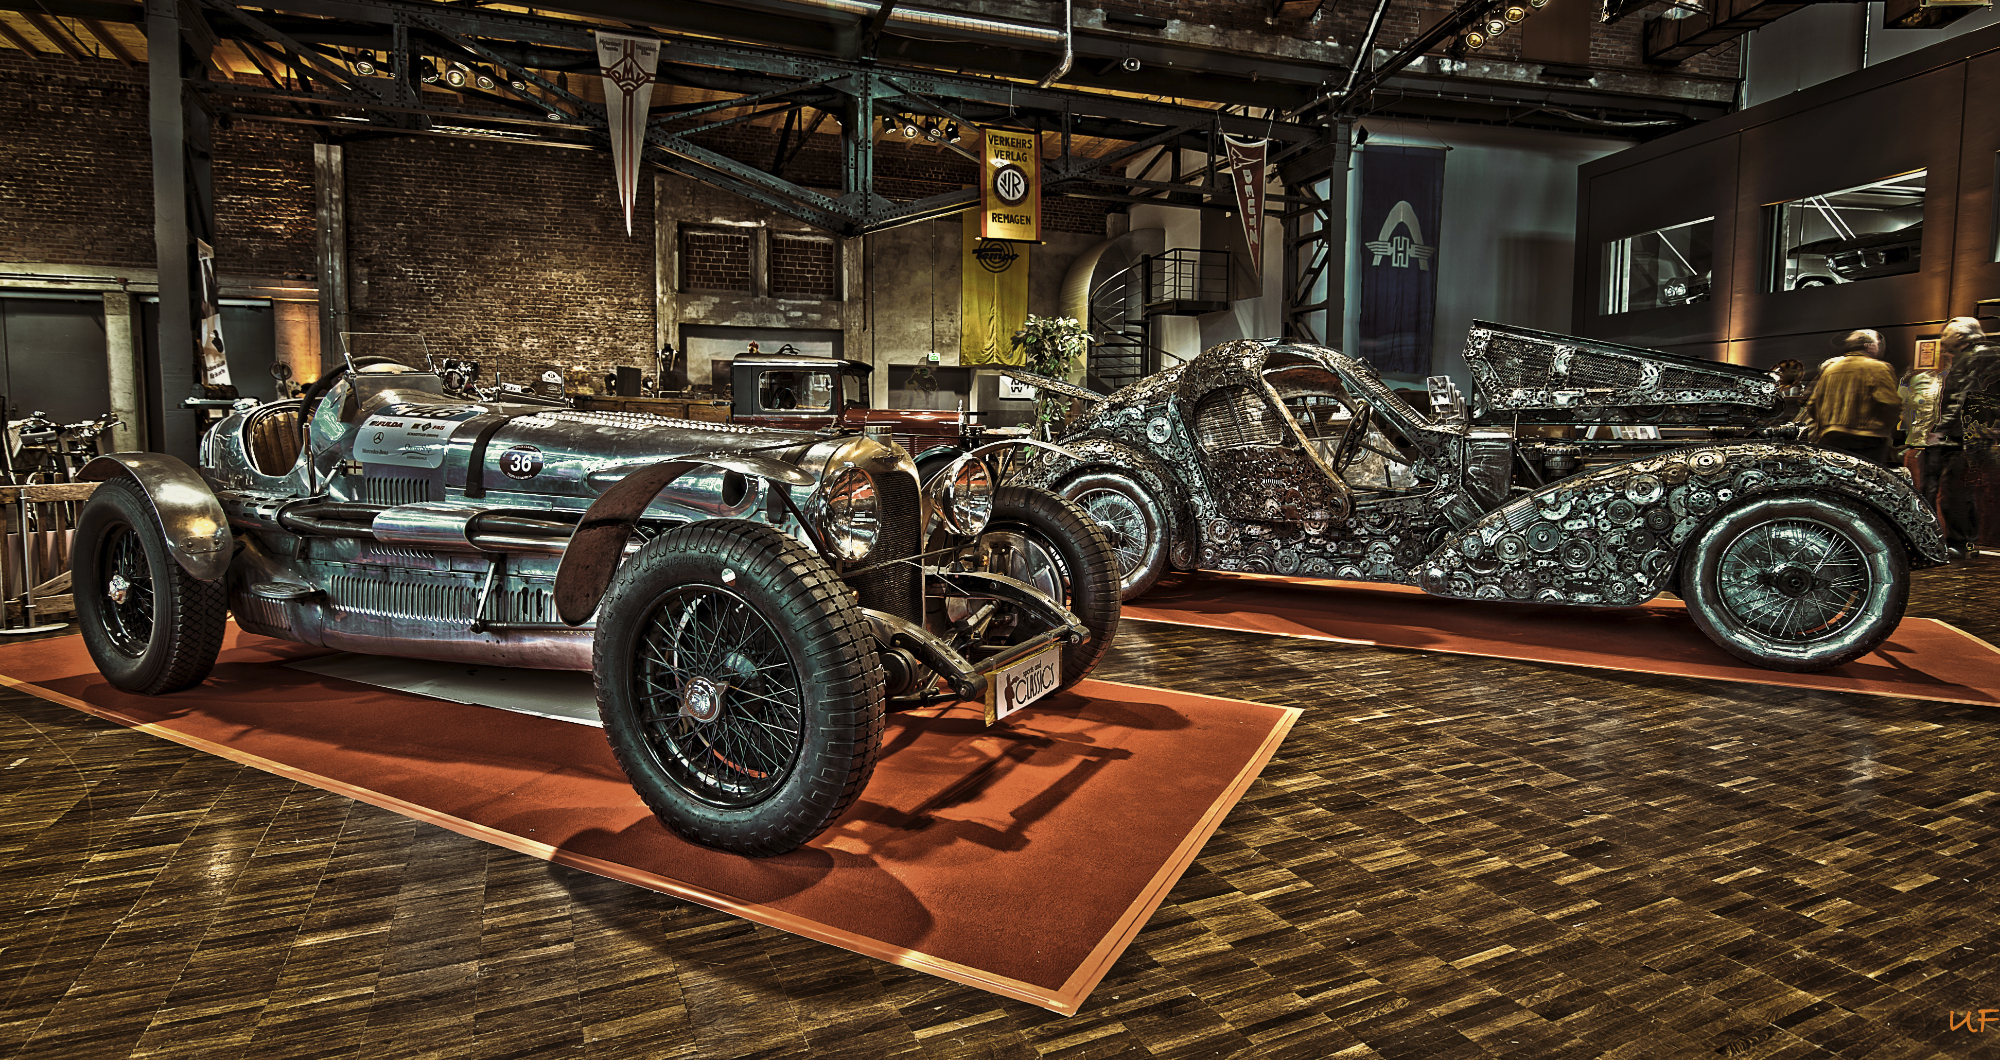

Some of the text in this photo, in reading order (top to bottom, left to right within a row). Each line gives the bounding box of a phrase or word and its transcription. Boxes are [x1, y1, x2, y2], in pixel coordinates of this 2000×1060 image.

[988, 134, 1033, 149] VERKEHRS
[994, 149, 1028, 162] VERLAG
[1242, 169, 1258, 244] DEUTZ
[992, 212, 1031, 225] REMAGEN
[972, 247, 1019, 262] Tempo
[510, 454, 532, 472] 36
[1023, 659, 1042, 677] sports and
[1015, 662, 1055, 704] CLASSICS
